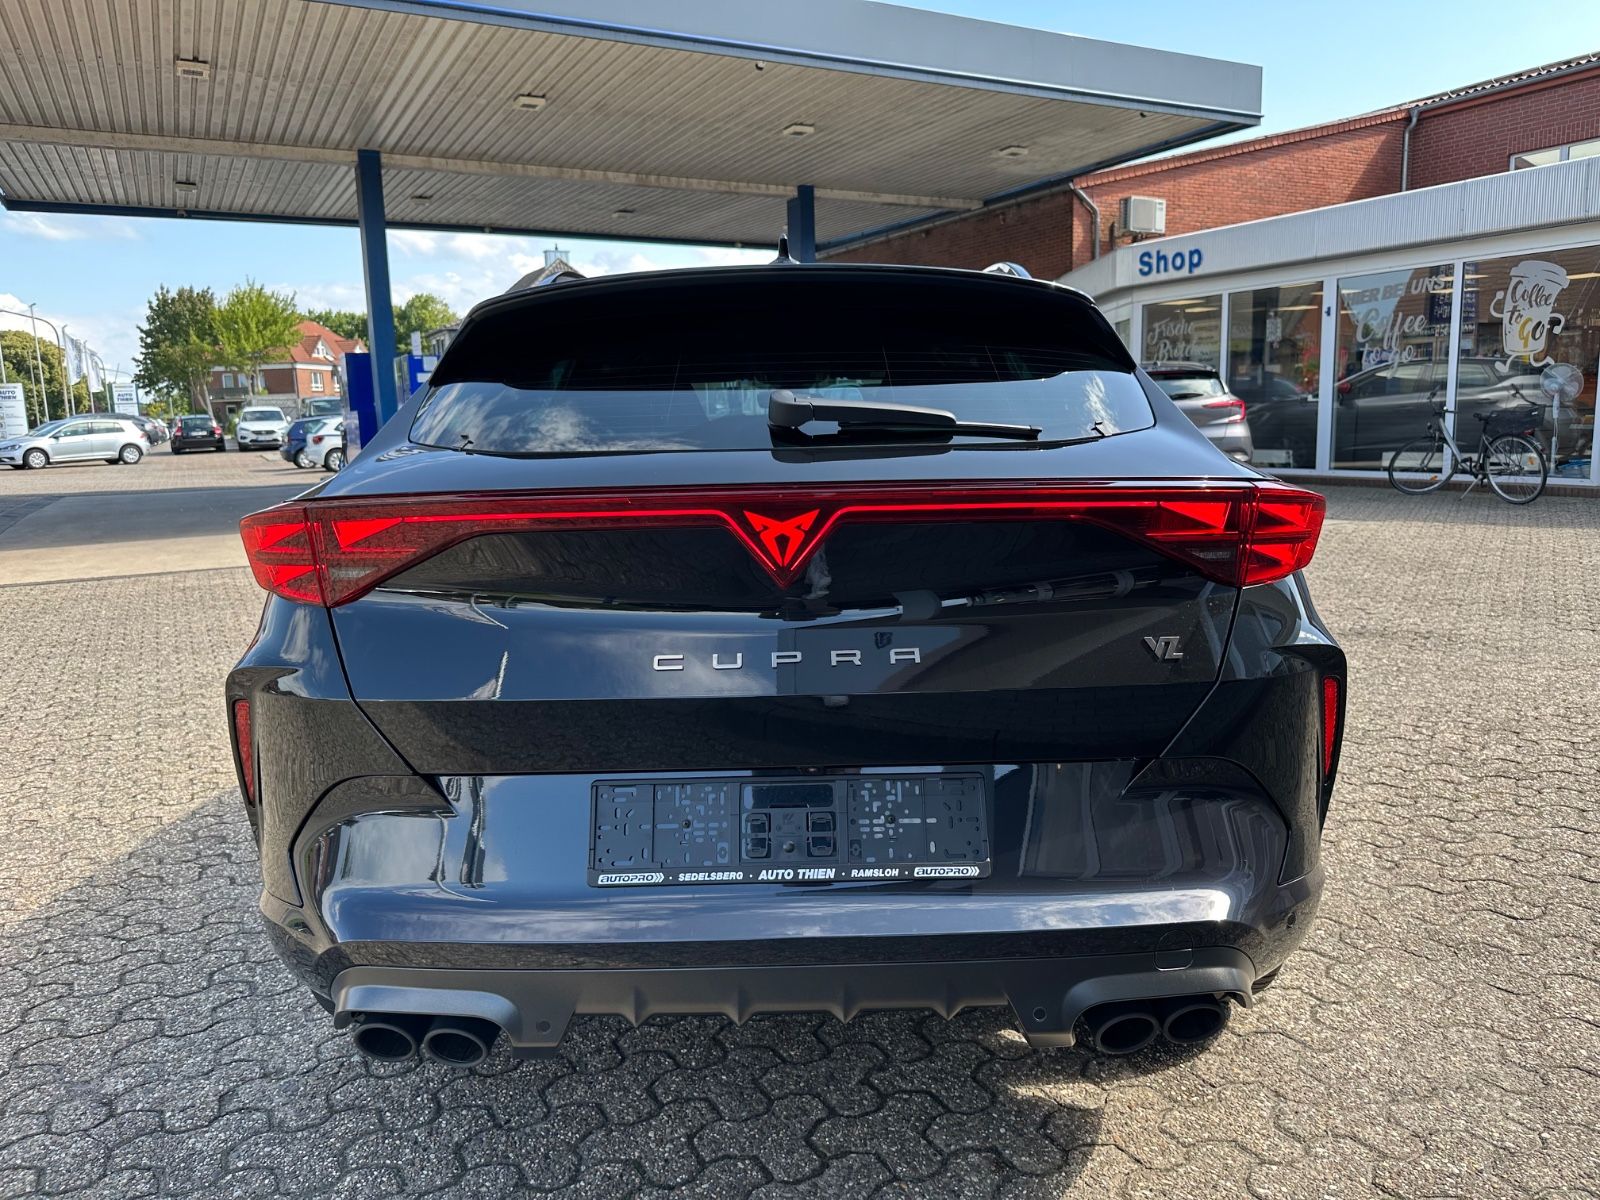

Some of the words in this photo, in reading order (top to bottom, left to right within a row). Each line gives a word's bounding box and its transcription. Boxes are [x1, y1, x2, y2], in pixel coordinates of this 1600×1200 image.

[1138, 248, 1203, 277] Shop
[1410, 275, 1446, 295] UNS
[1511, 279, 1553, 308] Coffee
[1505, 304, 1523, 326] to
[1356, 307, 1427, 350] Coffee
[1360, 342, 1381, 371] to
[653, 647, 921, 671] CUPRA
[1143, 635, 1184, 660] VZ
[678, 871, 744, 882] SEDELSBERG
[758, 869, 794, 880] AUTO
[797, 868, 836, 879] THIEN
[850, 868, 899, 878] RAMSLOH
